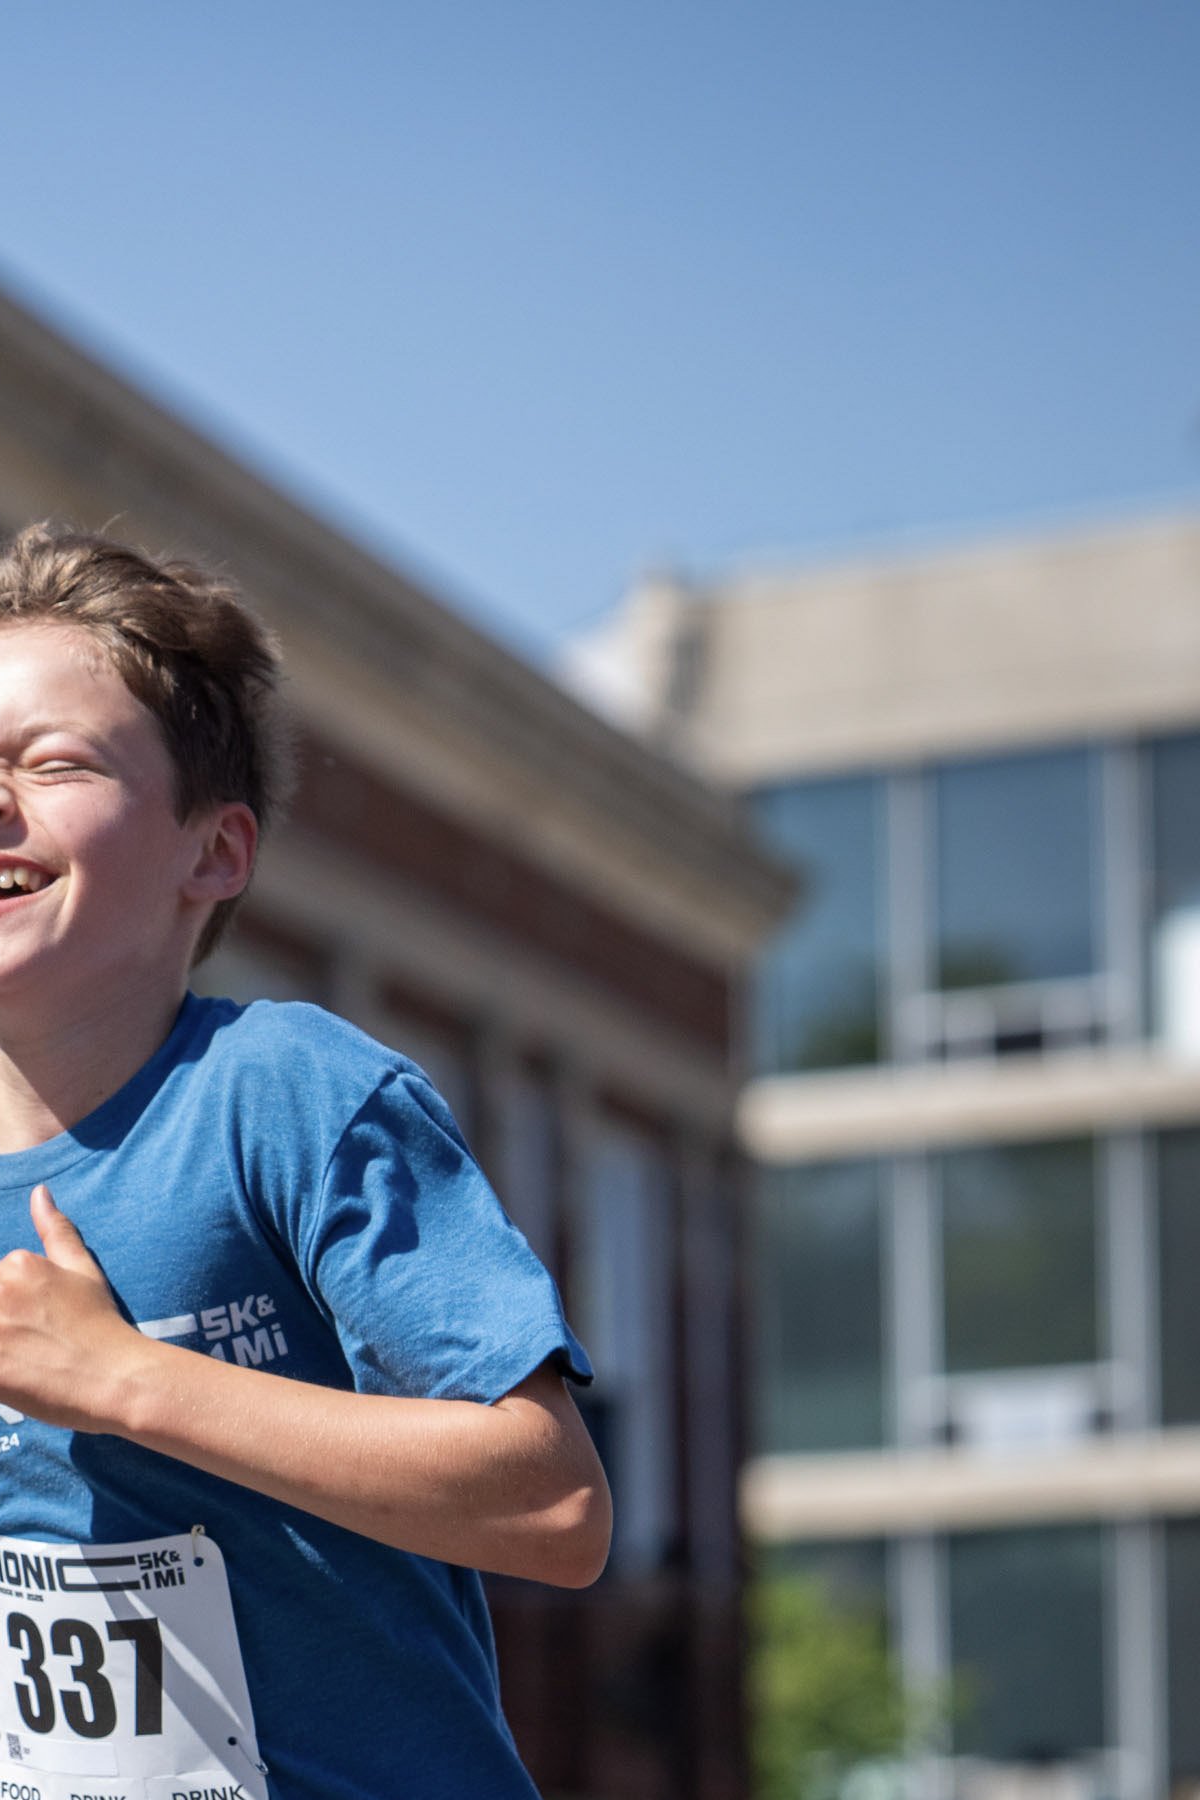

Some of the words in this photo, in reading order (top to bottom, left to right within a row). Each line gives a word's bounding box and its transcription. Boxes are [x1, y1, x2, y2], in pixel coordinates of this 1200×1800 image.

[201, 1294, 277, 1341] 5K&
[137, 1550, 182, 1570] 5K&
[6, 1611, 163, 1740] 337
